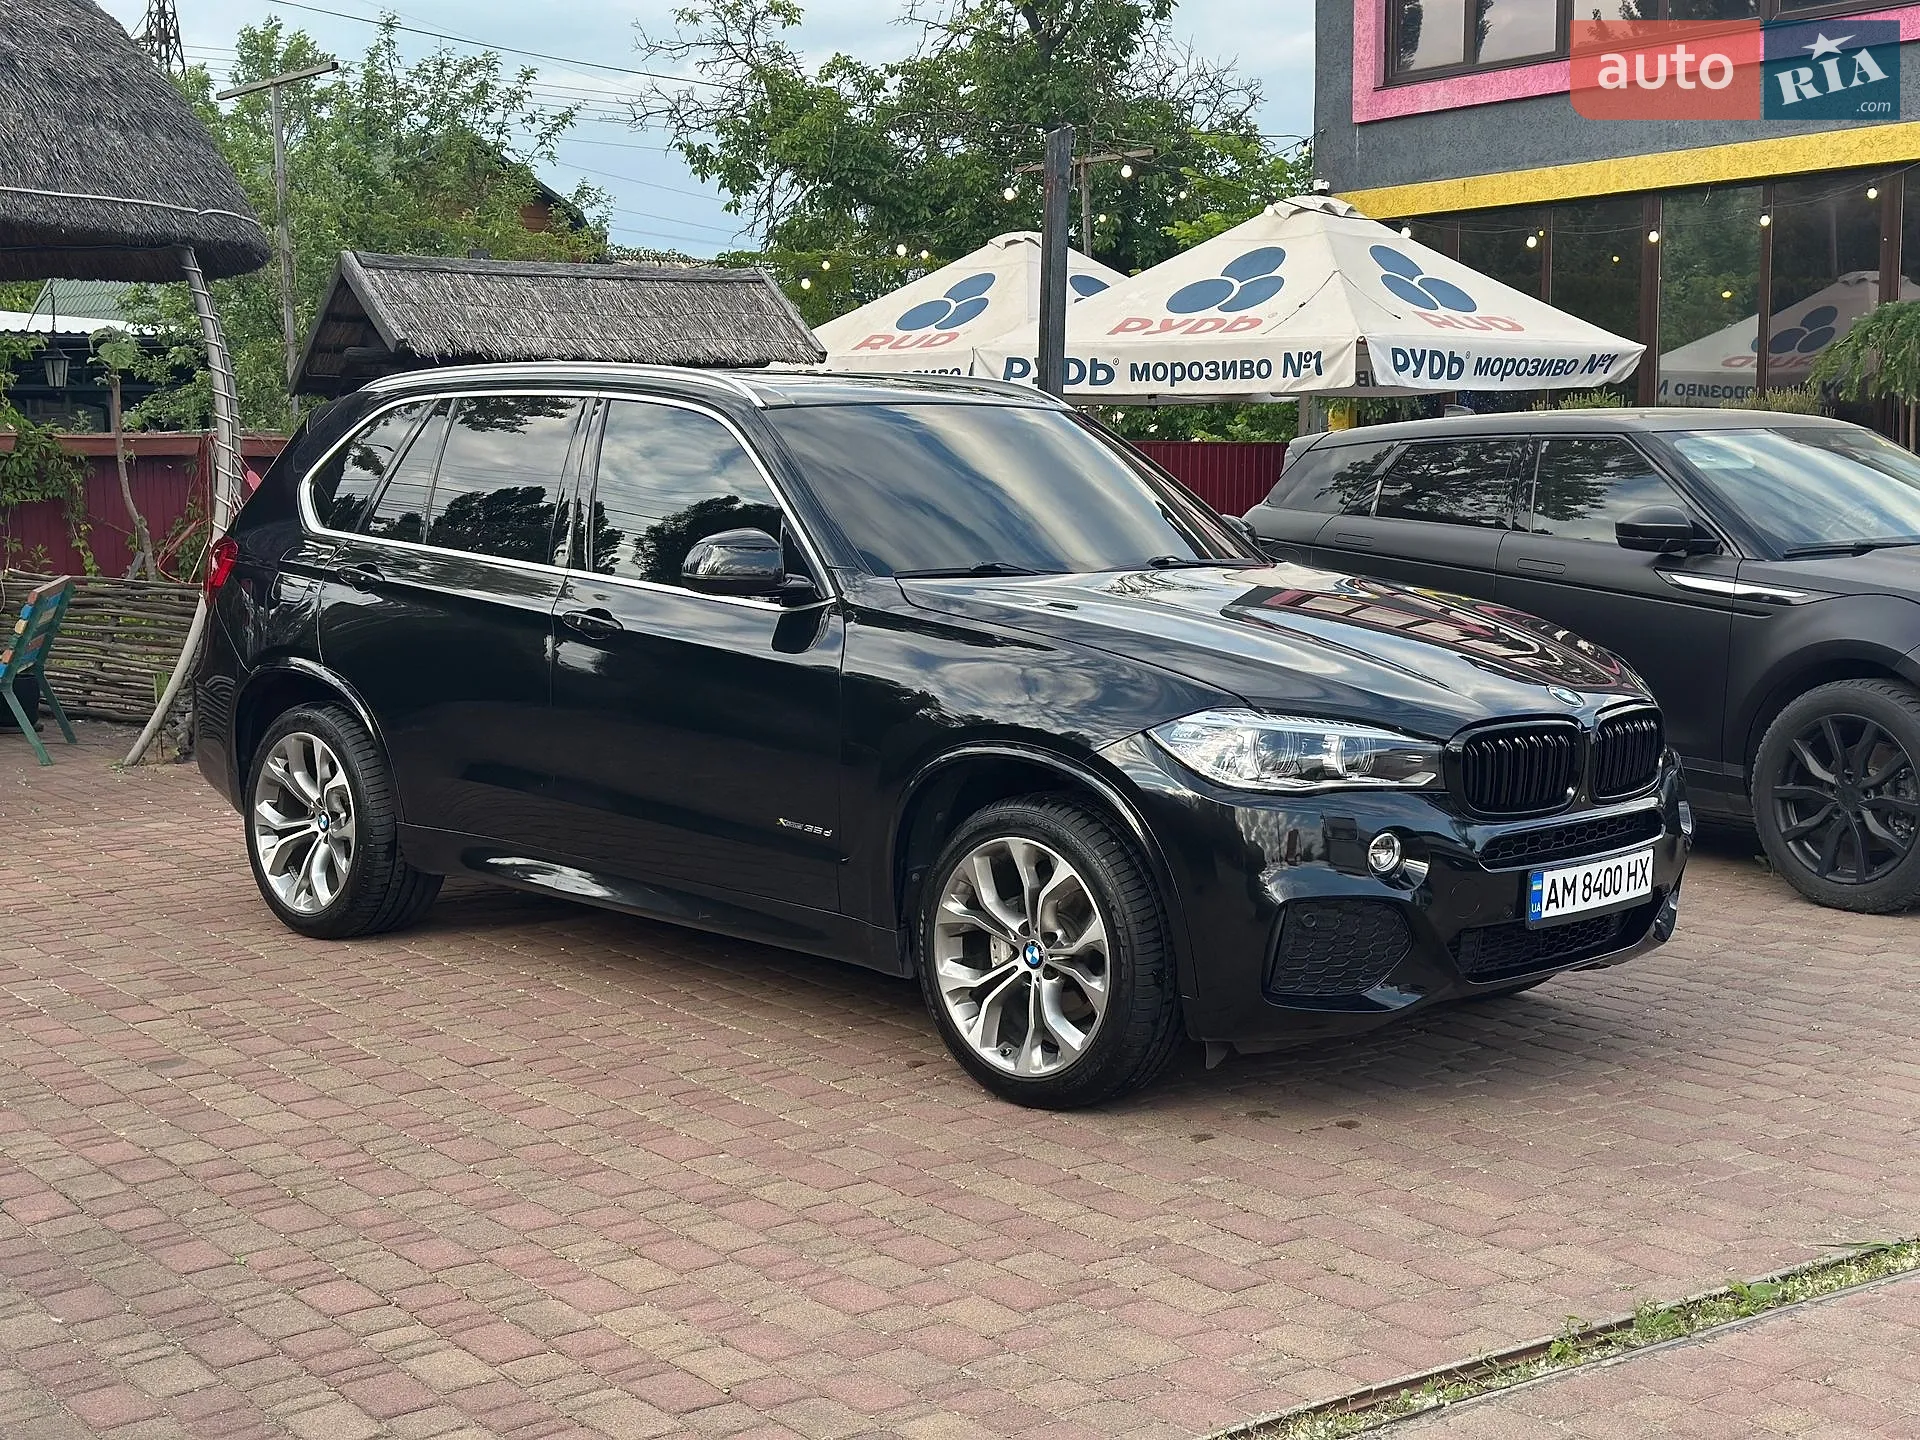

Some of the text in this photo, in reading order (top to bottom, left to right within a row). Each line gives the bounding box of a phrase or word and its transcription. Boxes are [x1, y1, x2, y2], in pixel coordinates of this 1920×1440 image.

[1412, 310, 1524, 332] RUD
[851, 332, 960, 351] RUD
[1003, 350, 1323, 387] РДЬ морозиво №1
[1473, 355, 1579, 382] морозиво
[1580, 353, 1619, 375] №1
[1545, 857, 1650, 911] AM 8400 HX
[1531, 902, 1542, 913] UA
